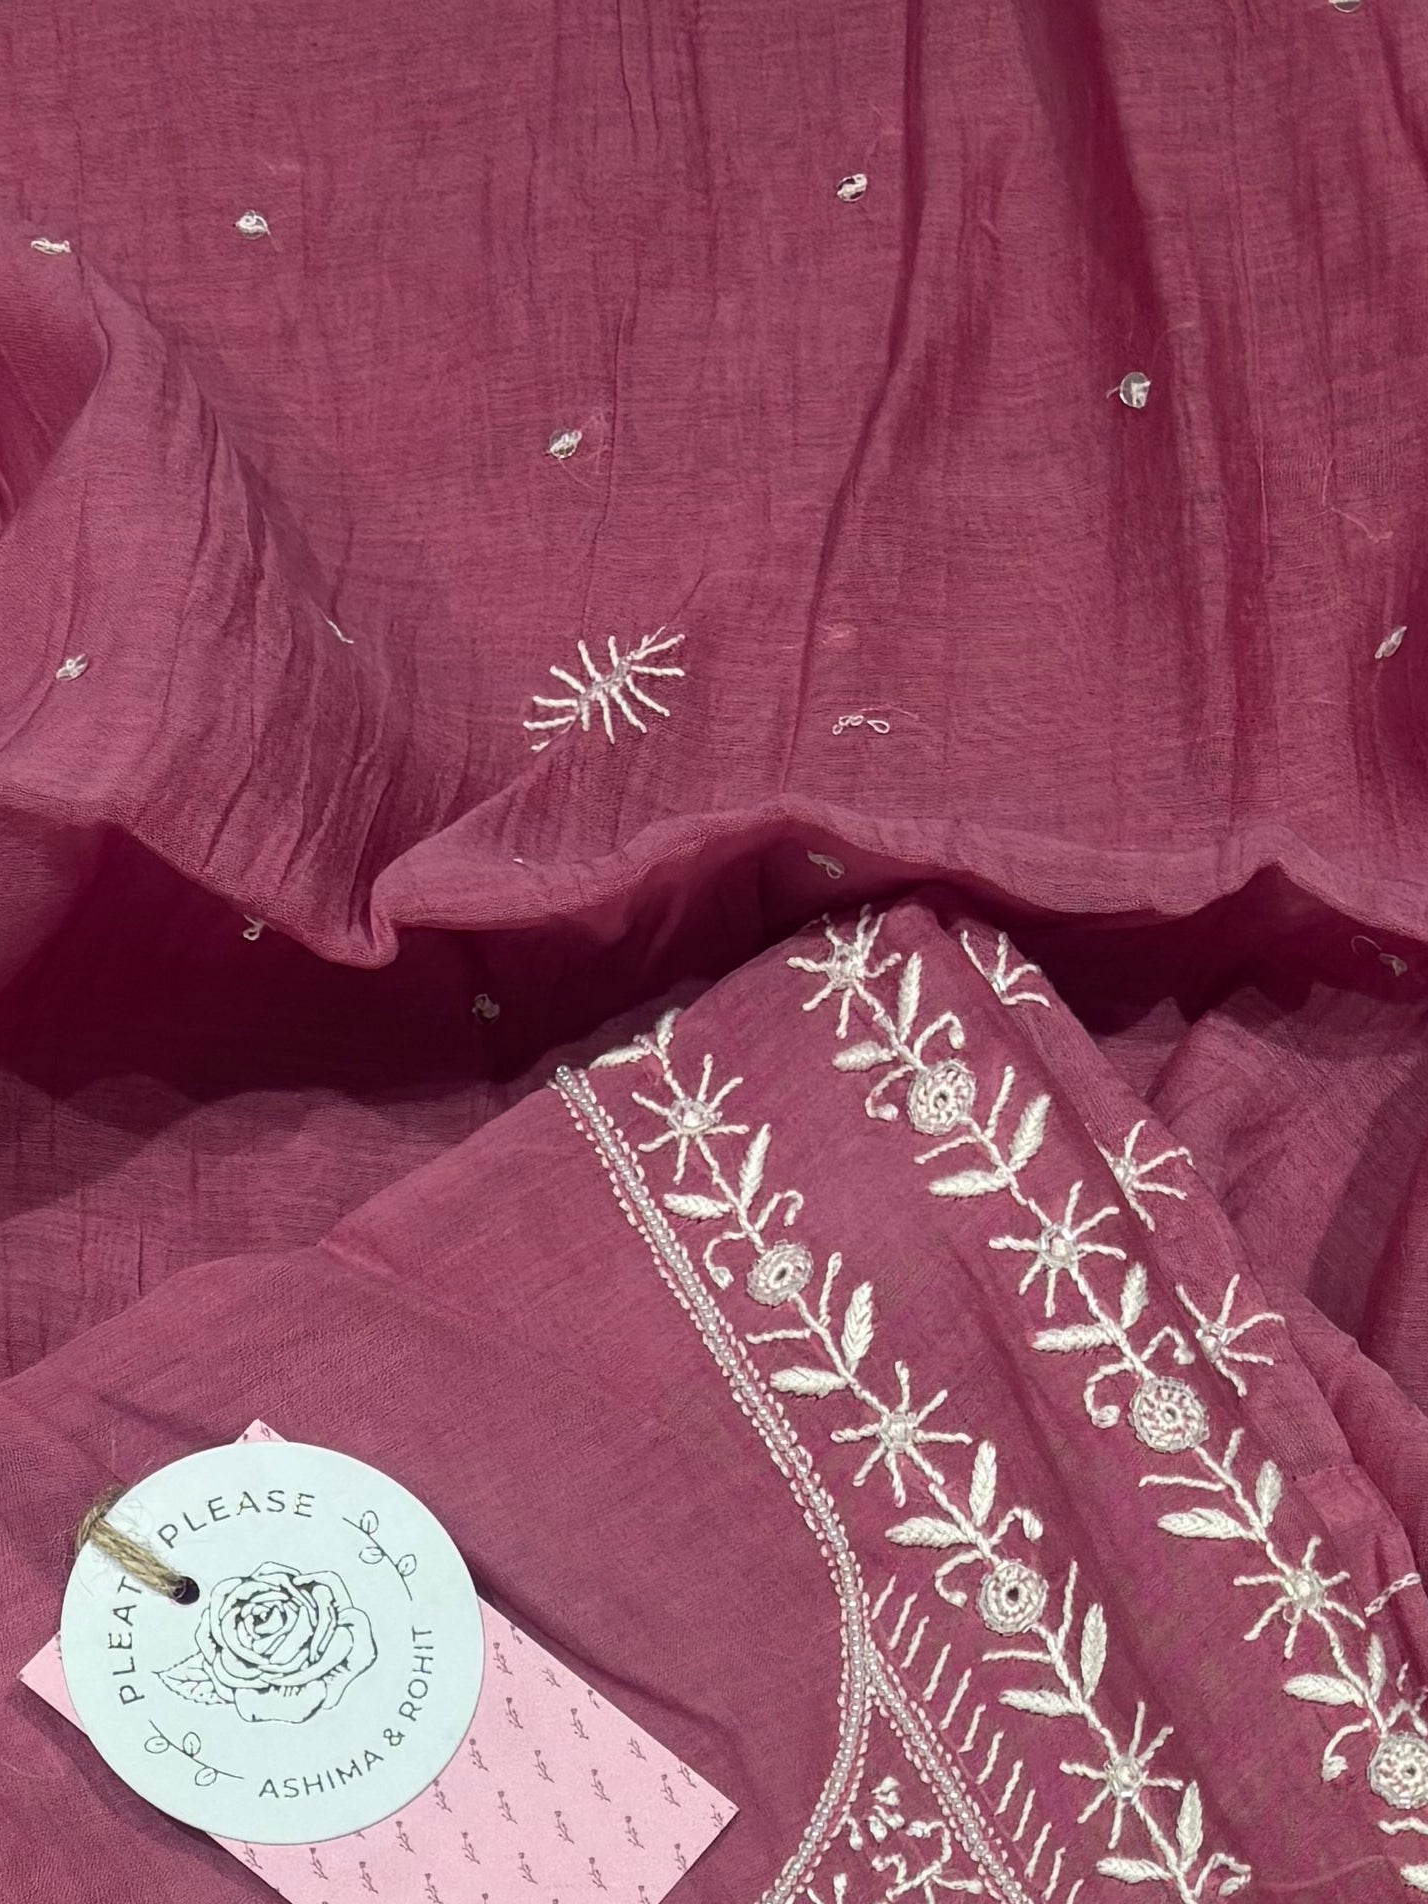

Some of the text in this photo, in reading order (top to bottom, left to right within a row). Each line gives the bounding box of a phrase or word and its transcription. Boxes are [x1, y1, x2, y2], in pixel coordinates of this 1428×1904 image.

[157, 1489, 315, 1550] PLEASE
[258, 1625, 434, 1799] ASHIMA & ROHIT
